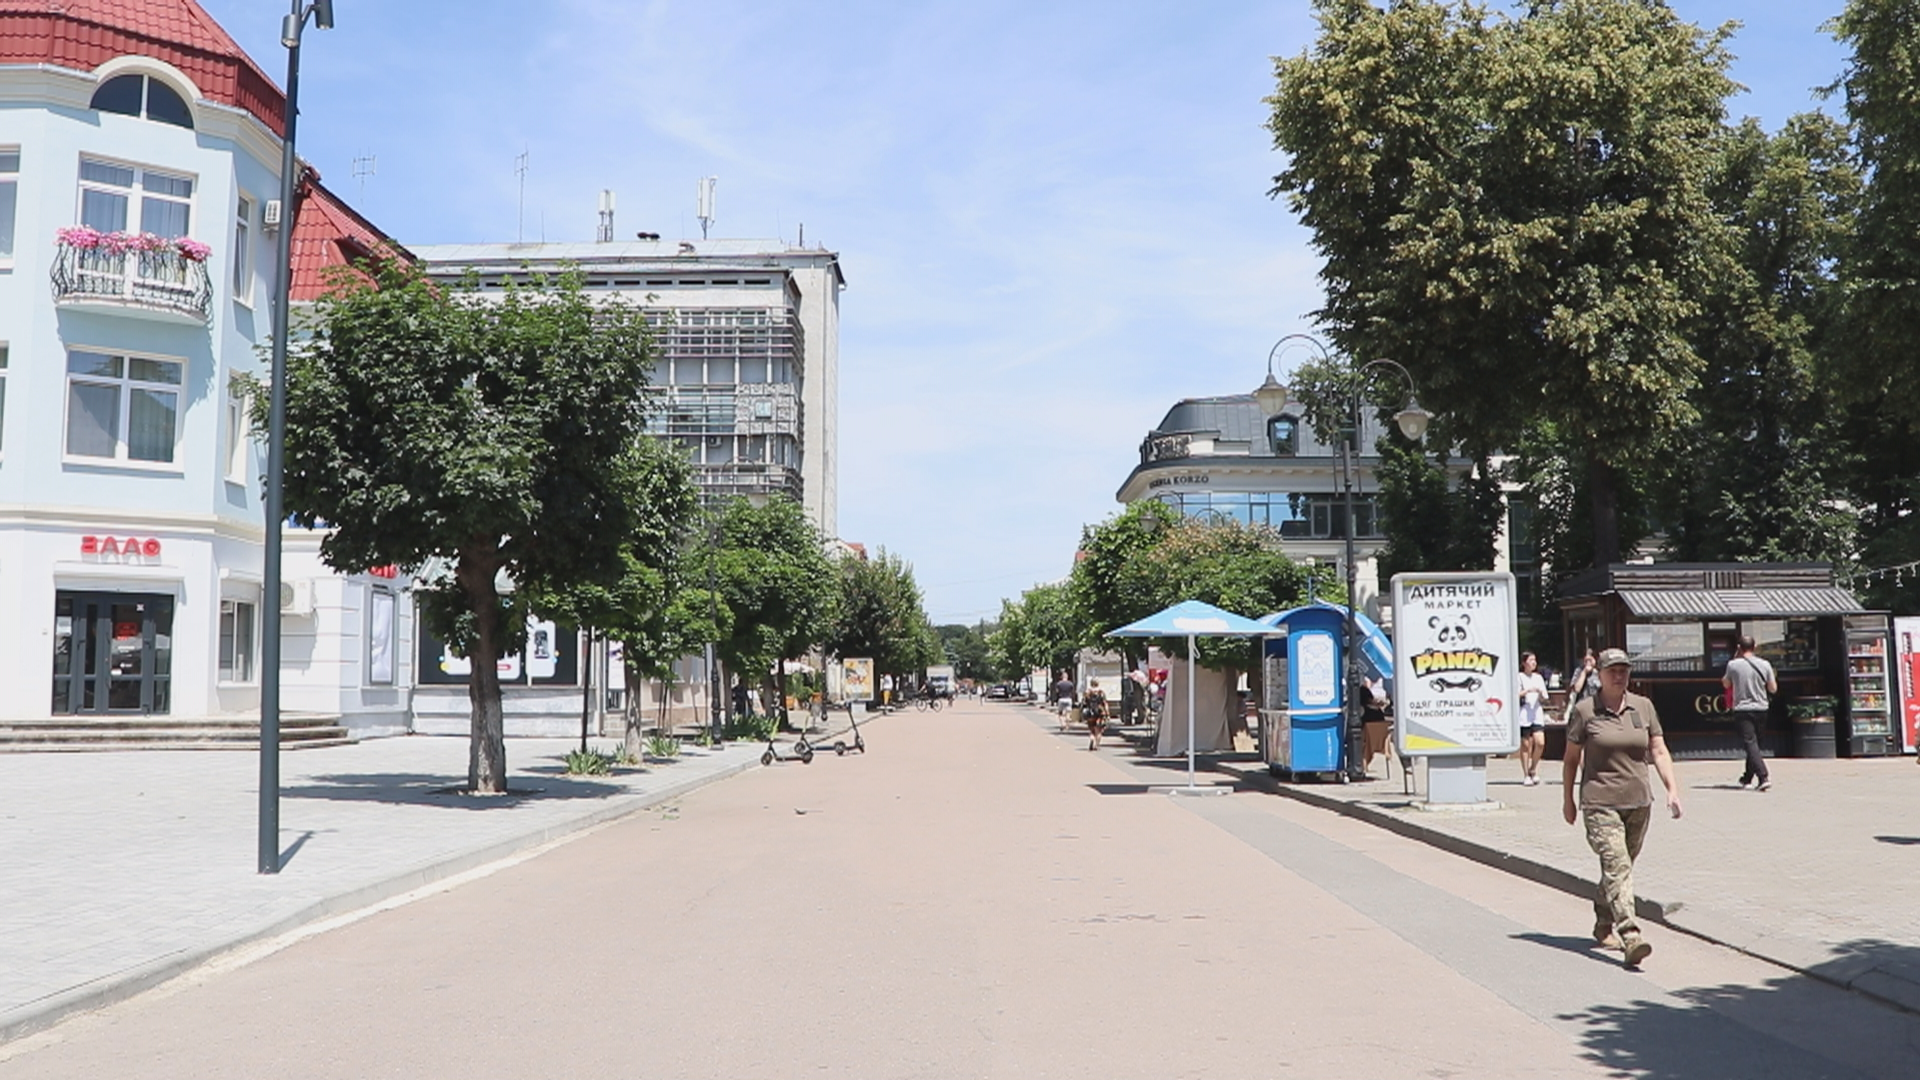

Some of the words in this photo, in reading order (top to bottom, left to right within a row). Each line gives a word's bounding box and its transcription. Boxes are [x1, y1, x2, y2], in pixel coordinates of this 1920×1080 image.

[1173, 475, 1209, 485] KORZO
[1410, 582, 1495, 599] ДИТЯЧИЙ
[1424, 600, 1482, 609] МАРКЕТ
[1415, 651, 1494, 677] PANDA
[1409, 700, 1431, 709] ОДЯГ
[1436, 699, 1475, 708] ІГРАШКИ
